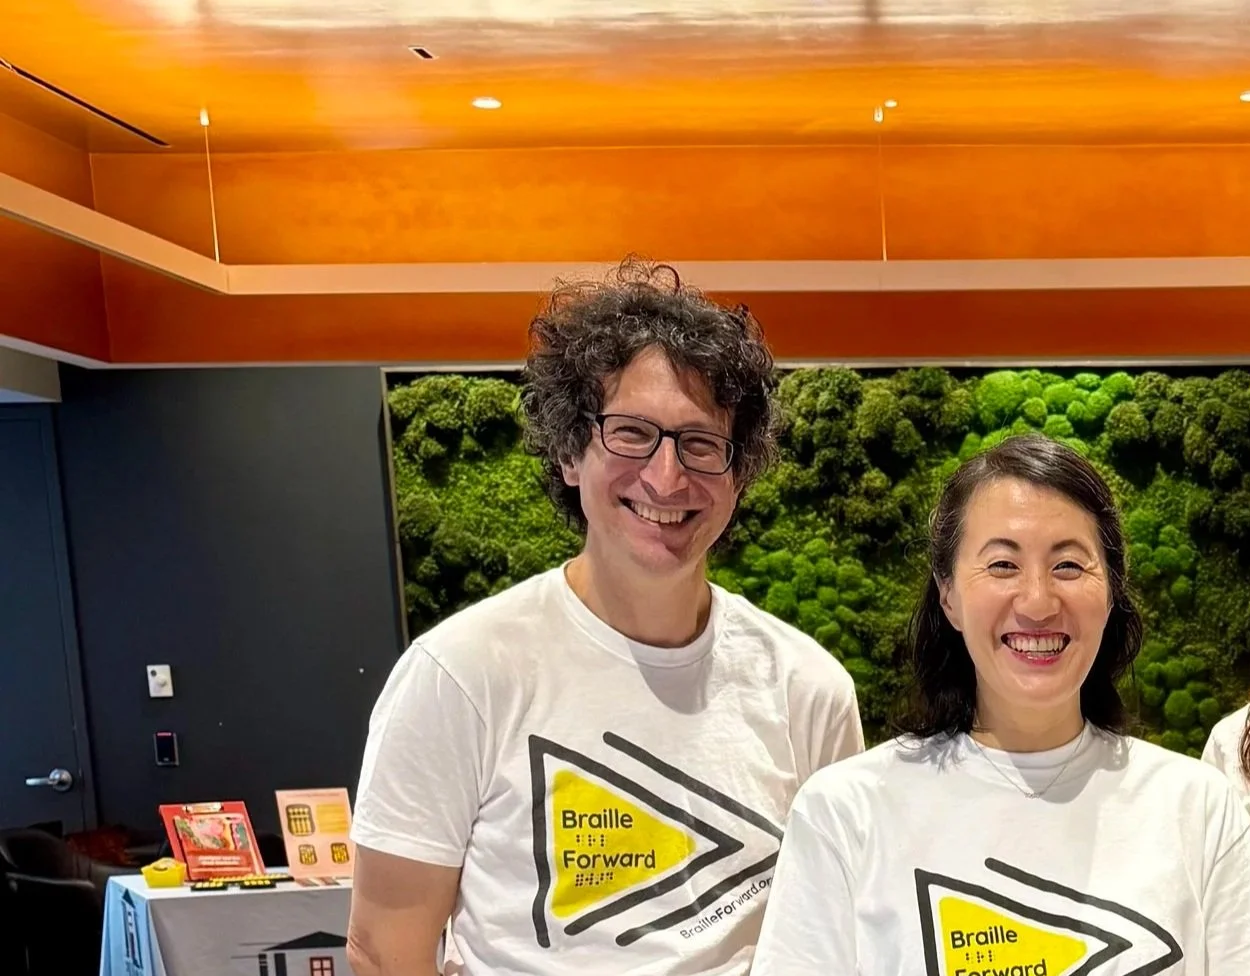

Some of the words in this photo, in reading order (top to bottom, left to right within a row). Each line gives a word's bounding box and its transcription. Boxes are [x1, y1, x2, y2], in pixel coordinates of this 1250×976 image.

[562, 808, 633, 829] Braille
[563, 849, 656, 869] Forward
[680, 876, 773, 940] BrailleForward.or
[950, 925, 1018, 949] Braille
